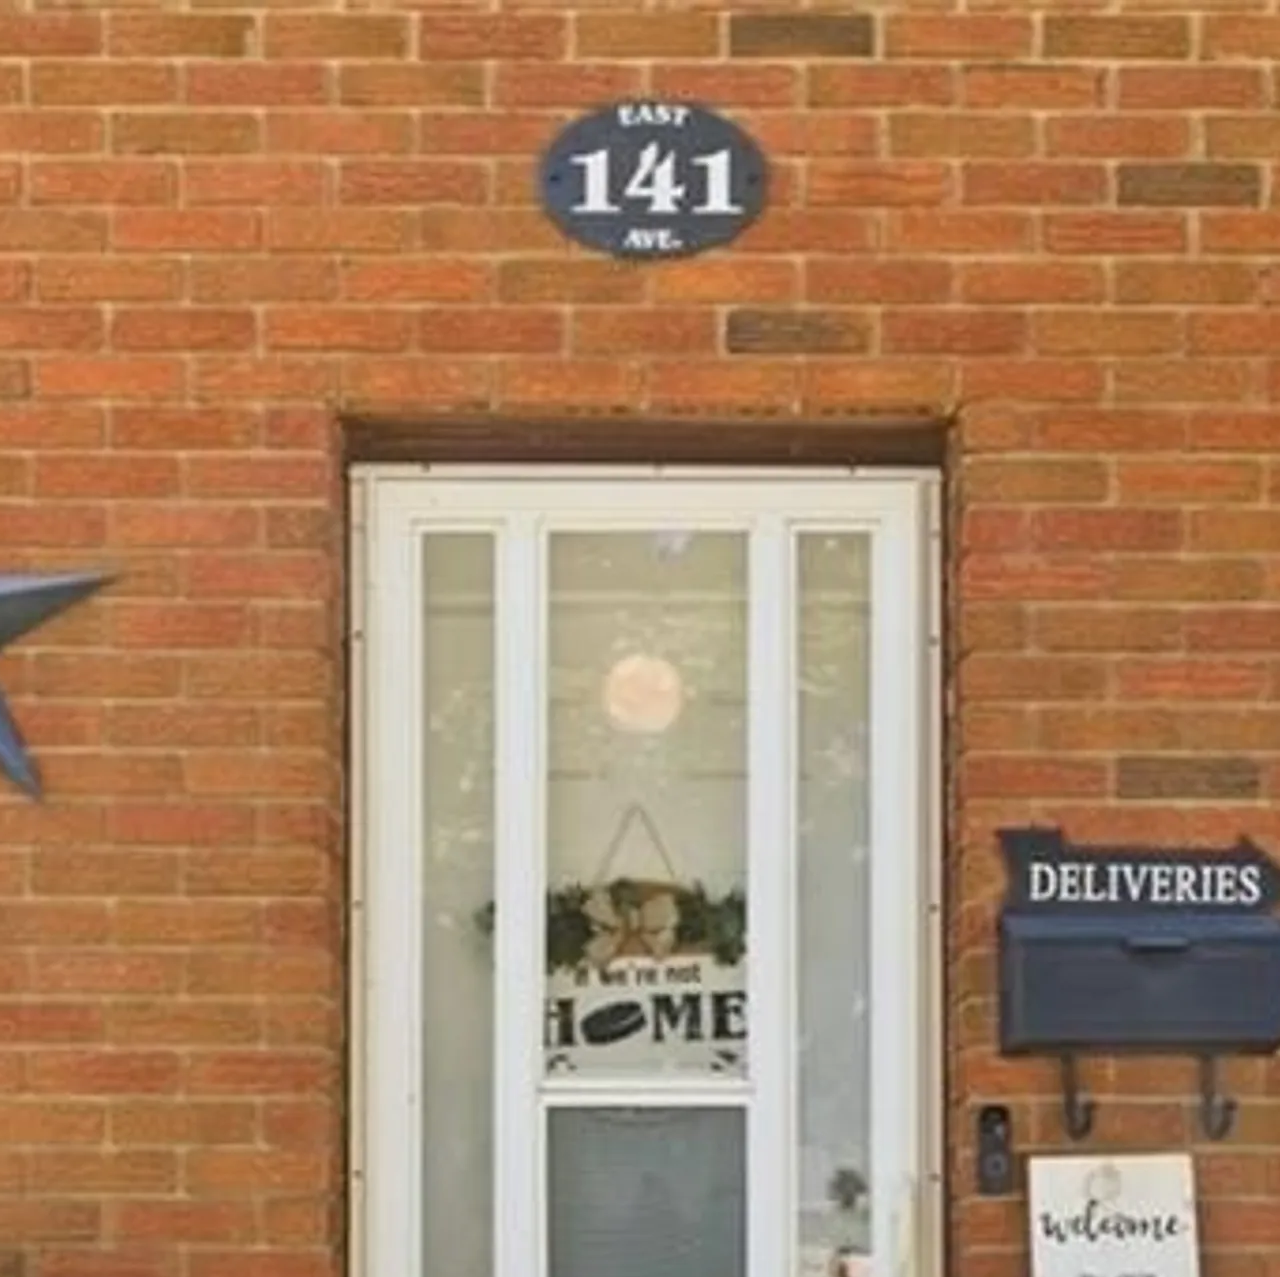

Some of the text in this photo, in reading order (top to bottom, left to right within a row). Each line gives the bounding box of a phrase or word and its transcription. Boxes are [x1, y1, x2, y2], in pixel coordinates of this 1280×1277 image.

[618, 104, 690, 126] EAST
[570, 142, 744, 214] 141
[623, 228, 683, 249] AVE.
[1028, 862, 1261, 905] DELIVERIES
[666, 964, 701, 984] not
